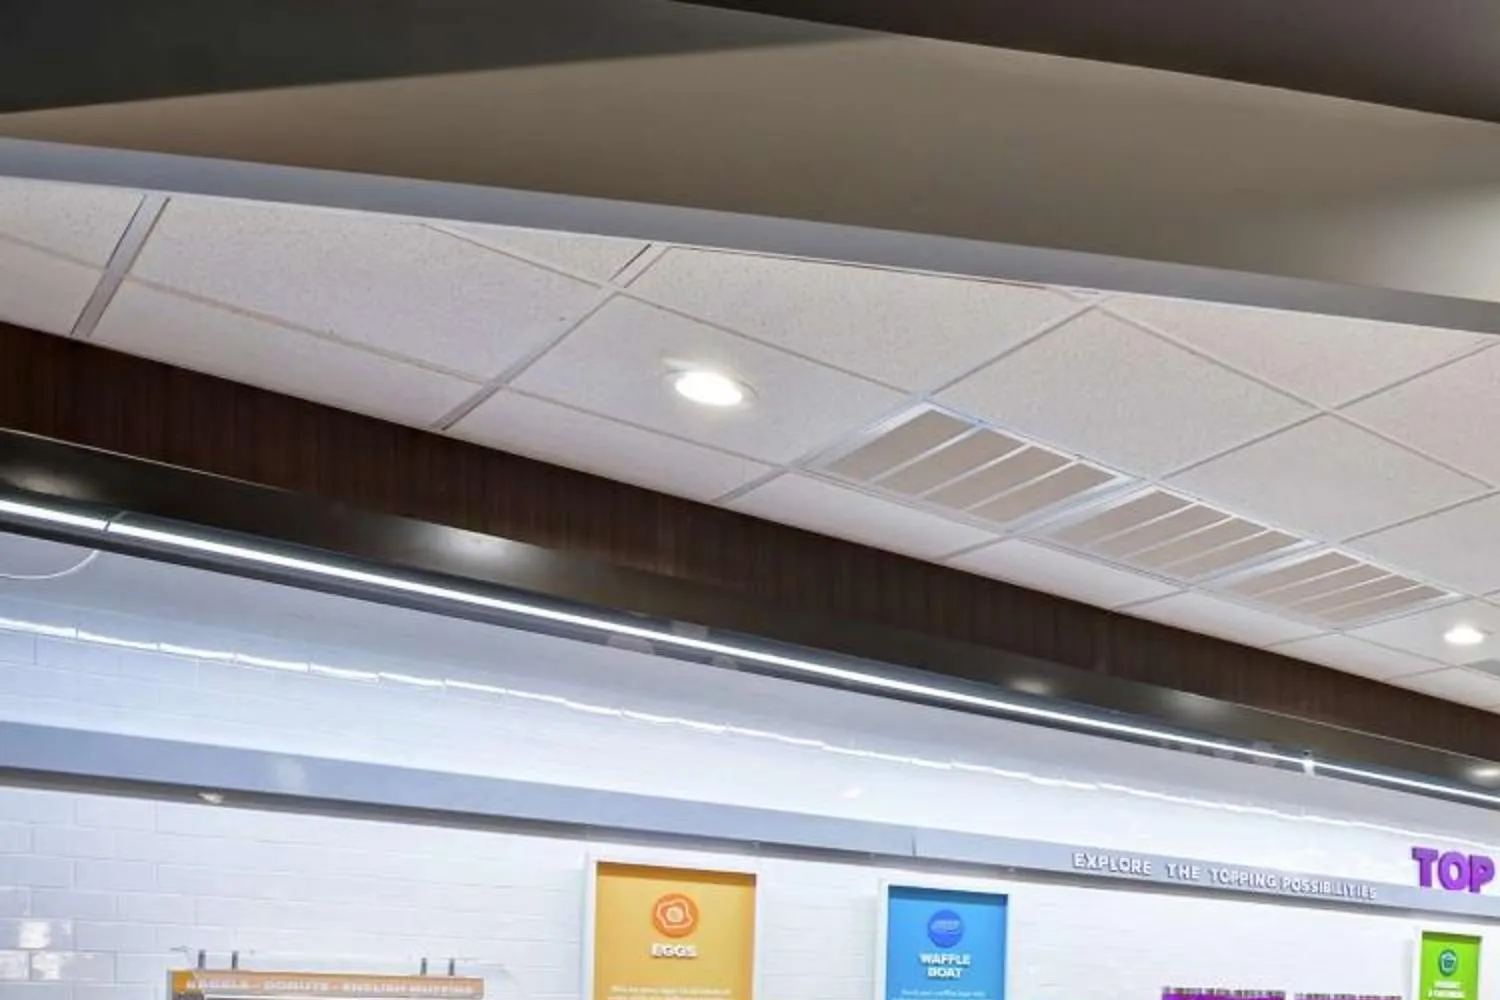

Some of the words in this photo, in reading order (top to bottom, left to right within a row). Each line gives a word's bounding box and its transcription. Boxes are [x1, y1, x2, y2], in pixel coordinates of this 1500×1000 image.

[1073, 852, 1151, 876] EXPLORE
[1166, 863, 1200, 881] THE
[1209, 868, 1277, 889] TOPPING
[1282, 877, 1377, 900] POSSIBILITIES
[1412, 847, 1495, 893] TOP
[651, 943, 698, 958] EGGS
[920, 953, 971, 965] WAFFLE
[927, 966, 962, 978] BOAT
